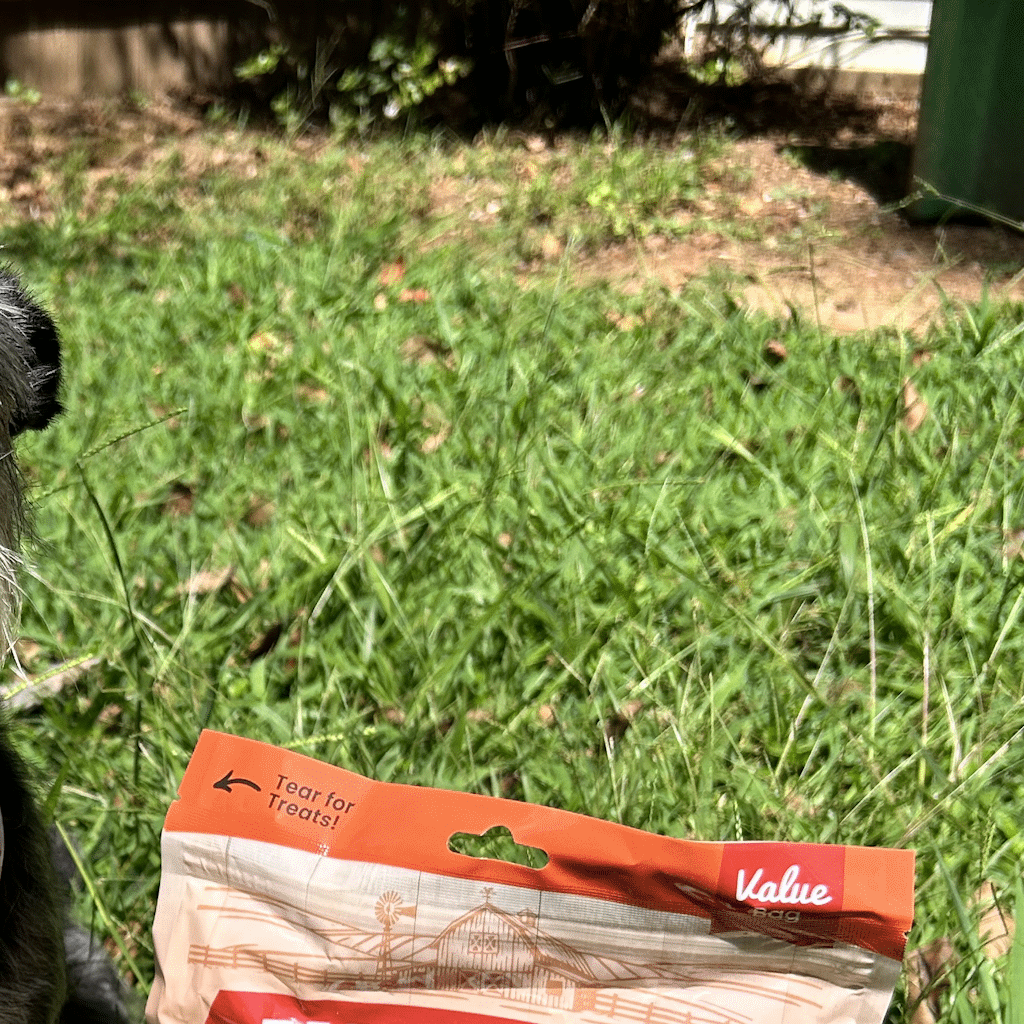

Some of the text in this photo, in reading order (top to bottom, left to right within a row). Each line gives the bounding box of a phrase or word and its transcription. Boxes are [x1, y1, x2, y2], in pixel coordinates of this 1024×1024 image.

[268, 792, 340, 830] Treats!
[276, 774, 366, 814] Tear for
[736, 864, 833, 906] Value
[752, 907, 801, 923] Bag
